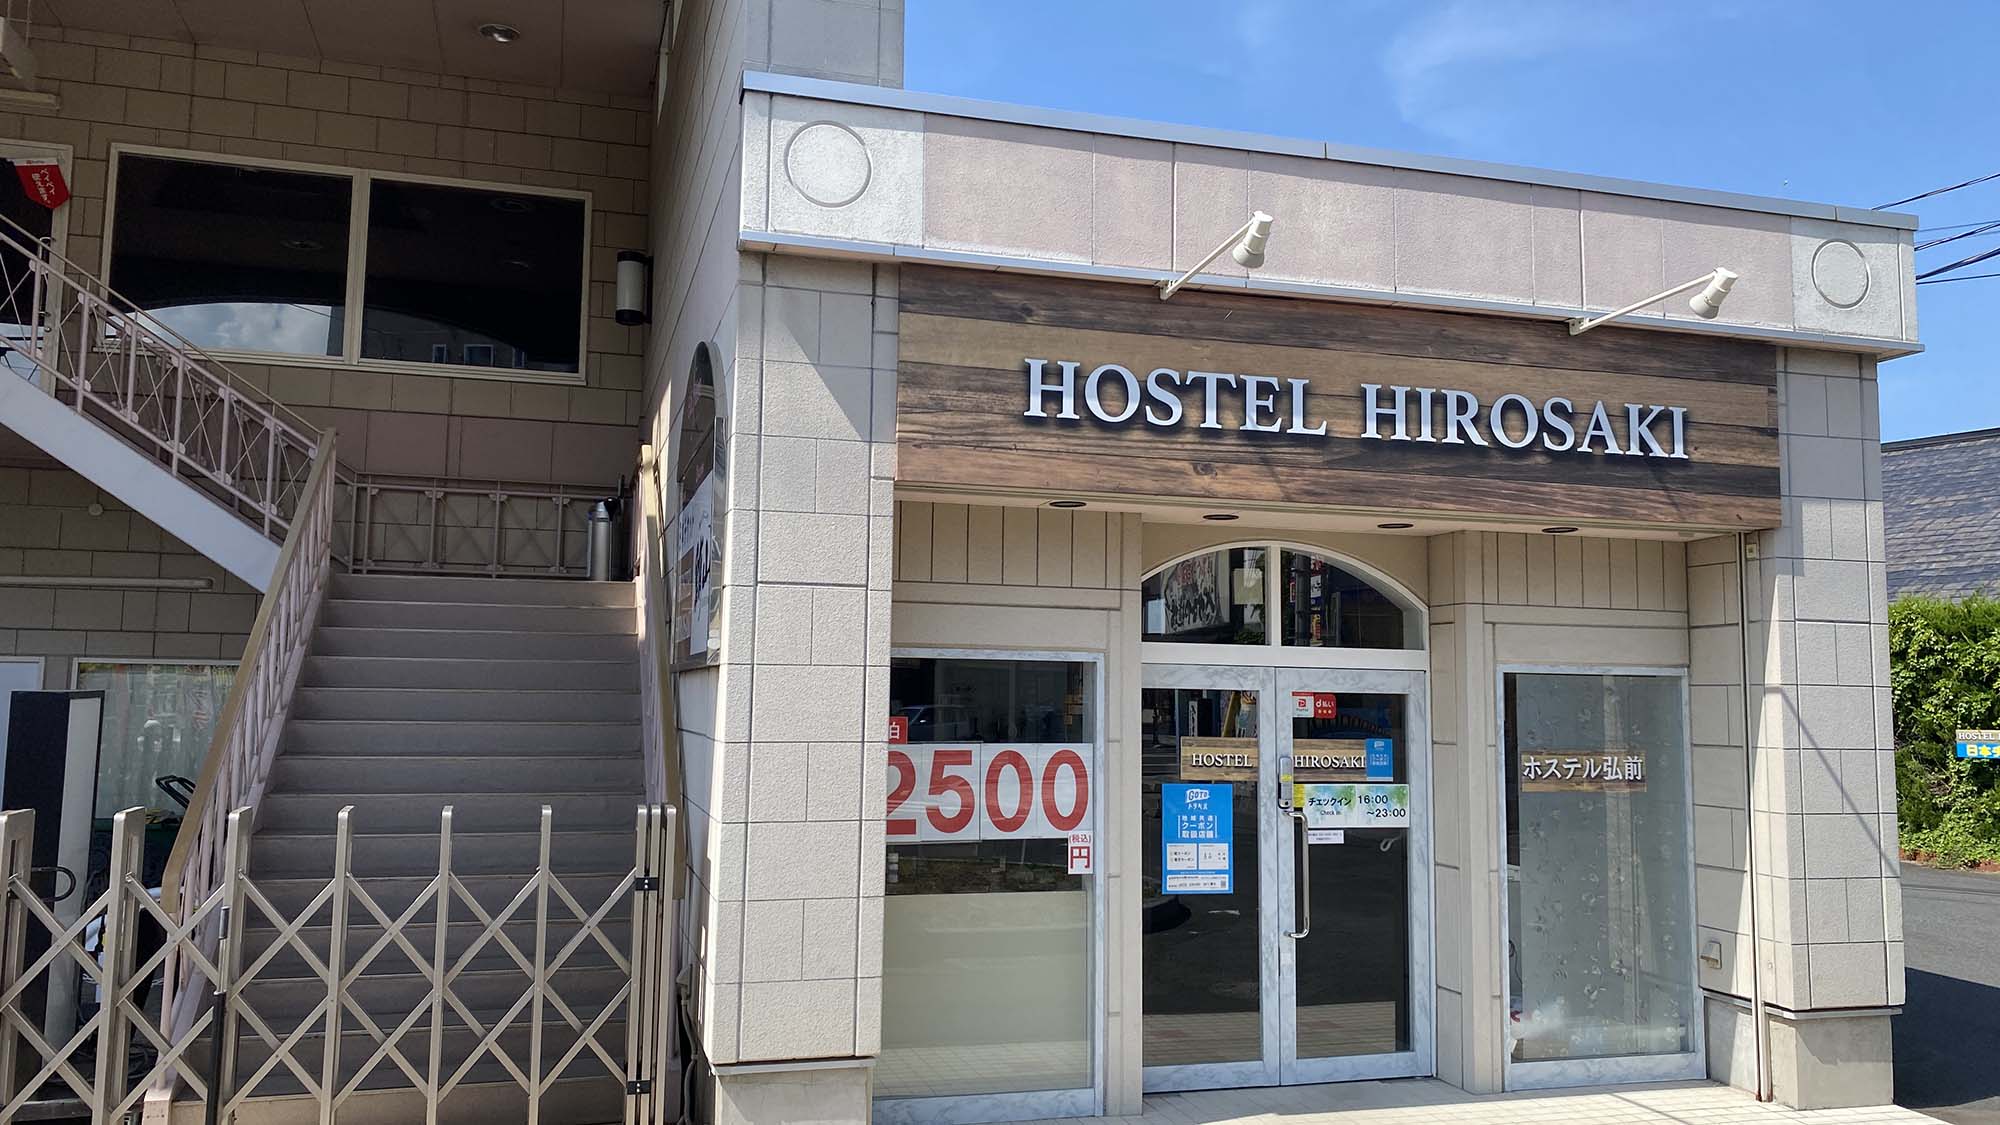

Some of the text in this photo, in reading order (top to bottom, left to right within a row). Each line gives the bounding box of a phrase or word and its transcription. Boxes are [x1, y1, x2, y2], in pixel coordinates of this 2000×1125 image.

[1023, 358, 1689, 459] HOSTEL HIROSAKI
[1959, 732, 1995, 740] HOSTEL
[1191, 753, 1253, 767] HOSTEL
[1294, 755, 1366, 768] HIROSAKI
[1523, 755, 1643, 780] ホステル弘前
[886, 749, 1089, 836] 2500
[1358, 794, 1388, 804] 16:00
[1308, 797, 1352, 807] チェックイン
[1182, 822, 1213, 830] クーポン
[1070, 846, 1090, 869] 円
